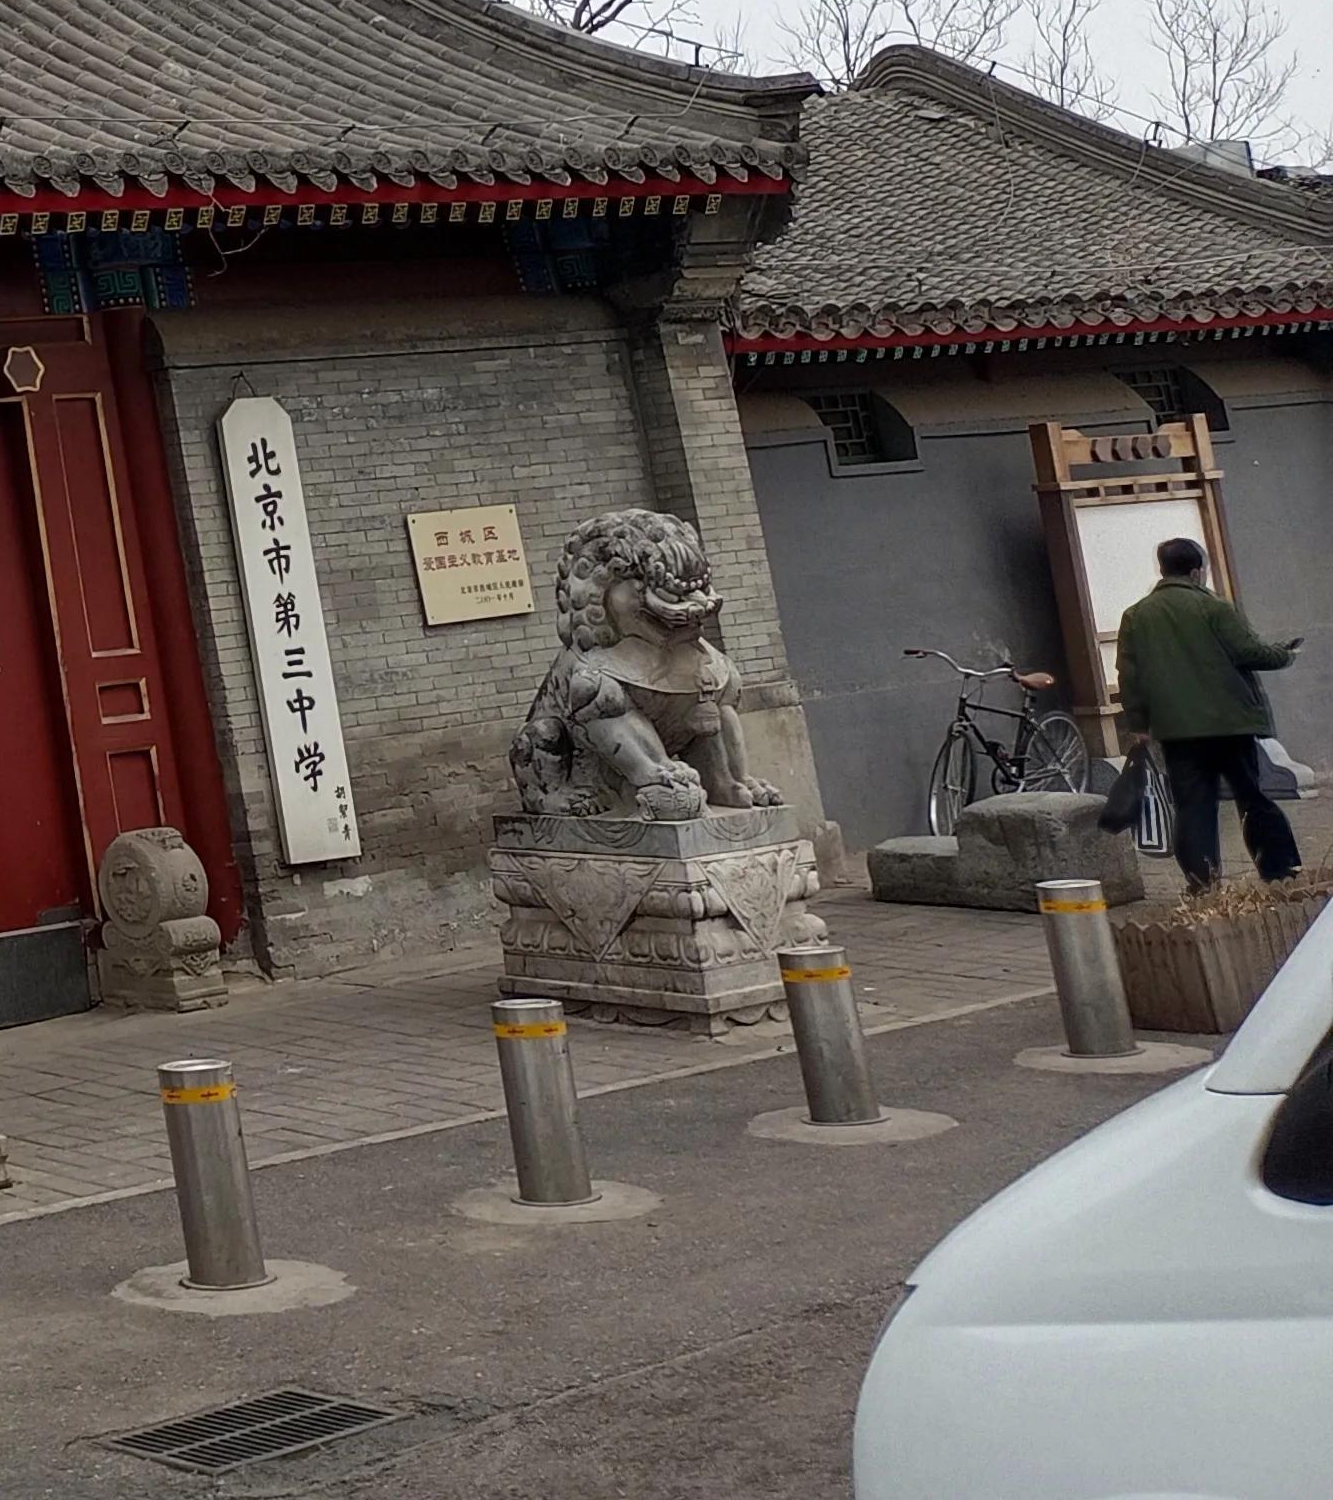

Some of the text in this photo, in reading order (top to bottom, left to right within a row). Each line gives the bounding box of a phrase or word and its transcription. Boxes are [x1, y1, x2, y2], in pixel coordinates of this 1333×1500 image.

[434, 526, 498, 546] 西城区
[423, 549, 520, 571] 爱国主义教育基地
[247, 437, 326, 793] 北京市第三中学
